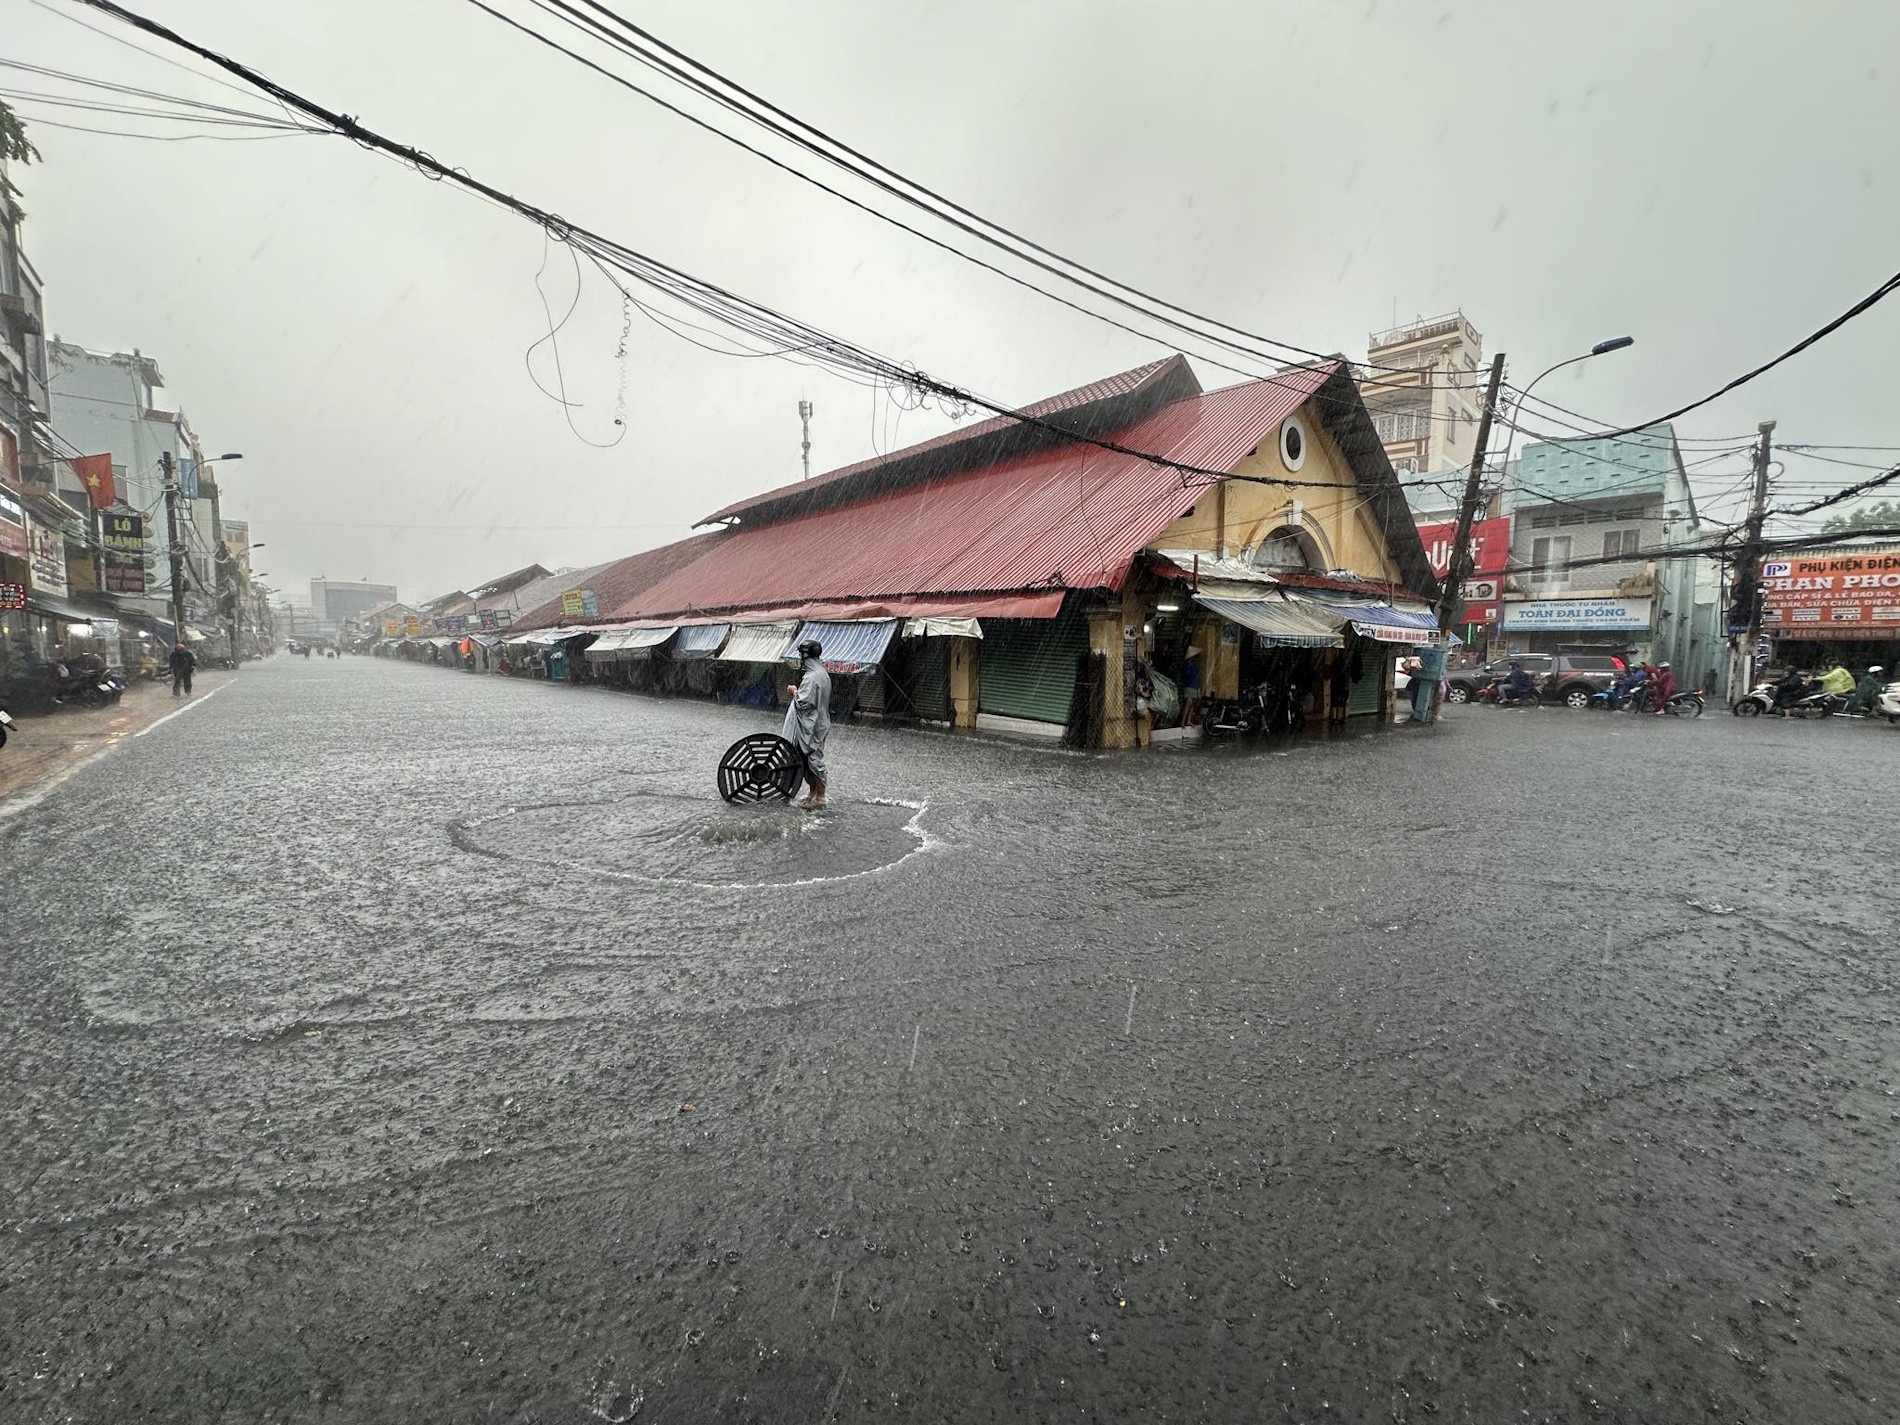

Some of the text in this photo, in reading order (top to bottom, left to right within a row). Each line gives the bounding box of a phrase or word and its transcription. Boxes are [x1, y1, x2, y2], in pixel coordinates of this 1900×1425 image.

[1800, 561, 1826, 573] PHỤ
[1830, 558, 1862, 572] KIỆN
[1518, 608, 1553, 618] TOÀN
